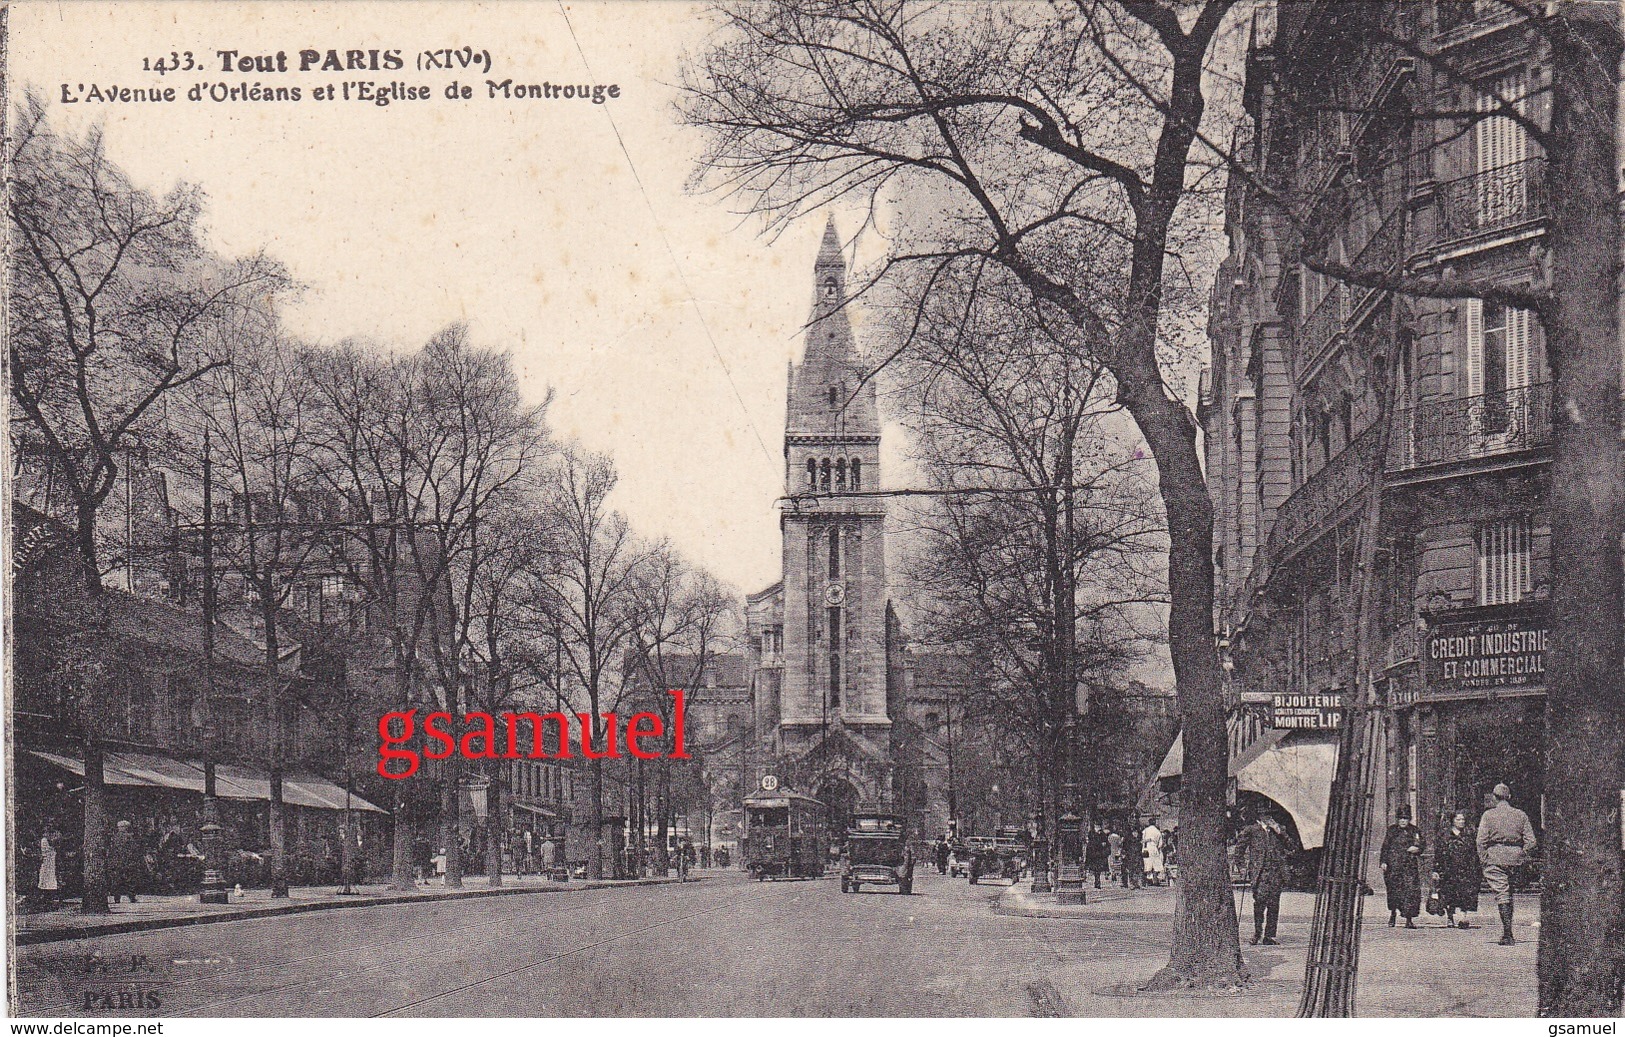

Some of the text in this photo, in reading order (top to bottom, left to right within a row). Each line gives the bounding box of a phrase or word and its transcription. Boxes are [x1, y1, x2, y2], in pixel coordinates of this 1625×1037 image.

[1444, 655, 1545, 679] ET COMMERCIAL
[1274, 695, 1341, 708] BIJOUTERIE
[1275, 713, 1341, 728] MONTRE LIP
